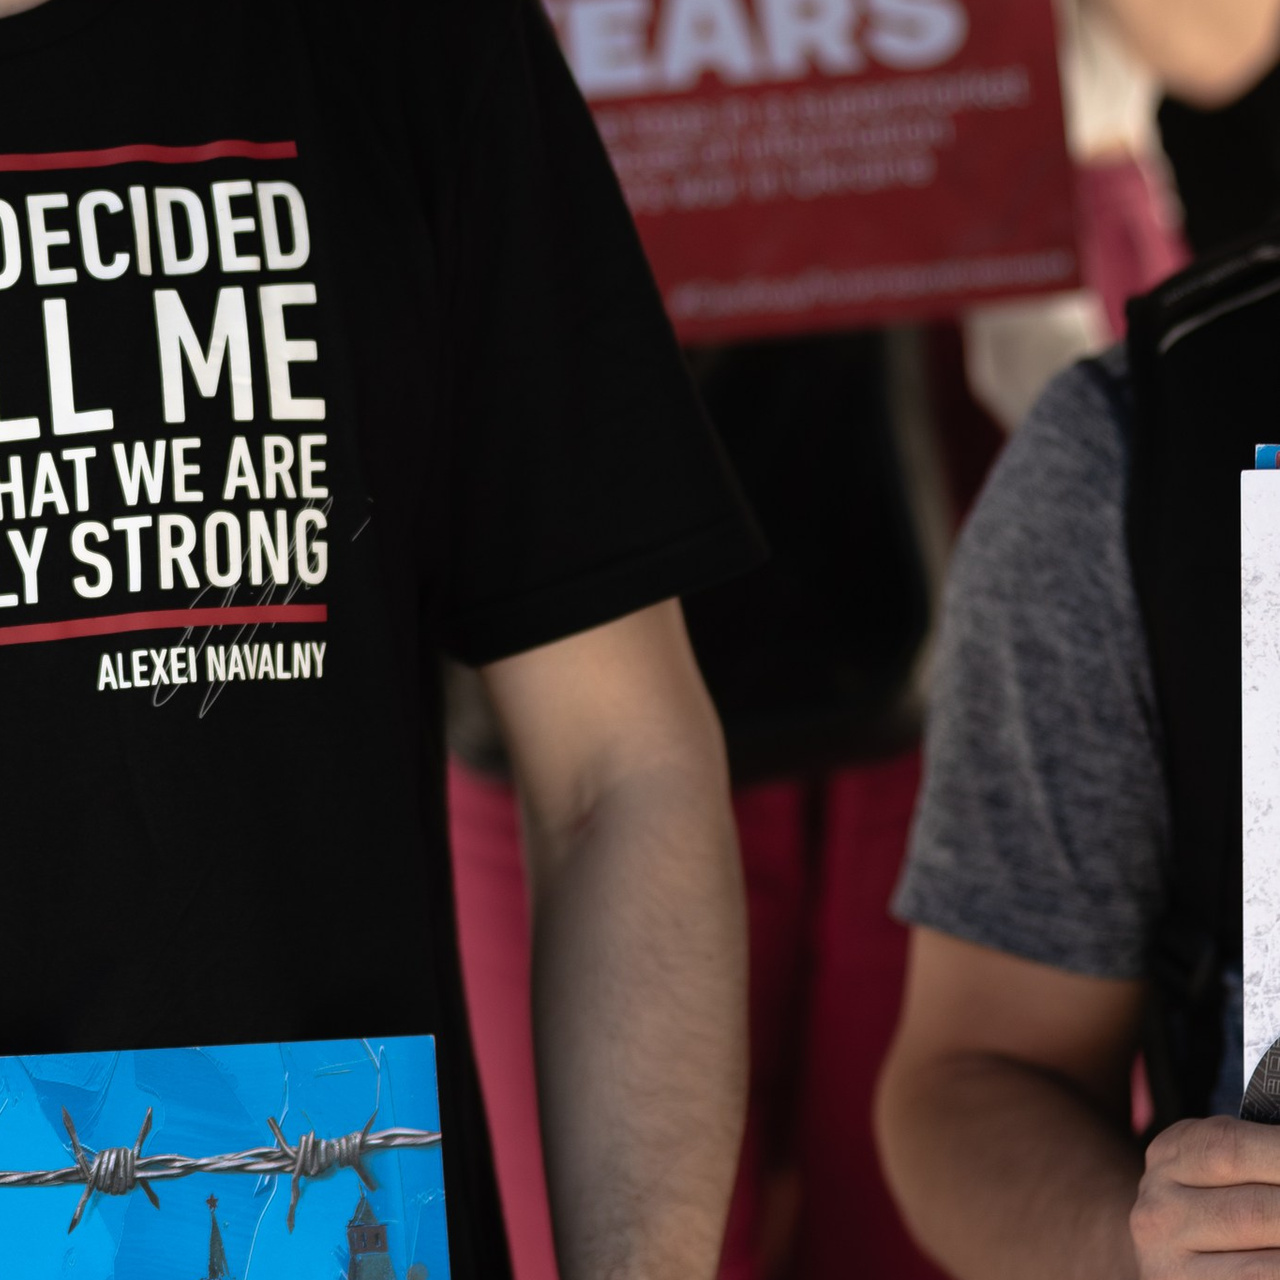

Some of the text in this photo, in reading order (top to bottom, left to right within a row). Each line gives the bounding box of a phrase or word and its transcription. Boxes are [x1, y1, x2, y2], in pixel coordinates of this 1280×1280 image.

[154, 282, 327, 424] ME
[112, 437, 203, 507] WE
[223, 433, 329, 501] ARE
[70, 508, 329, 599] STRONG
[97, 641, 328, 692] ALEXEI NAVALNY
